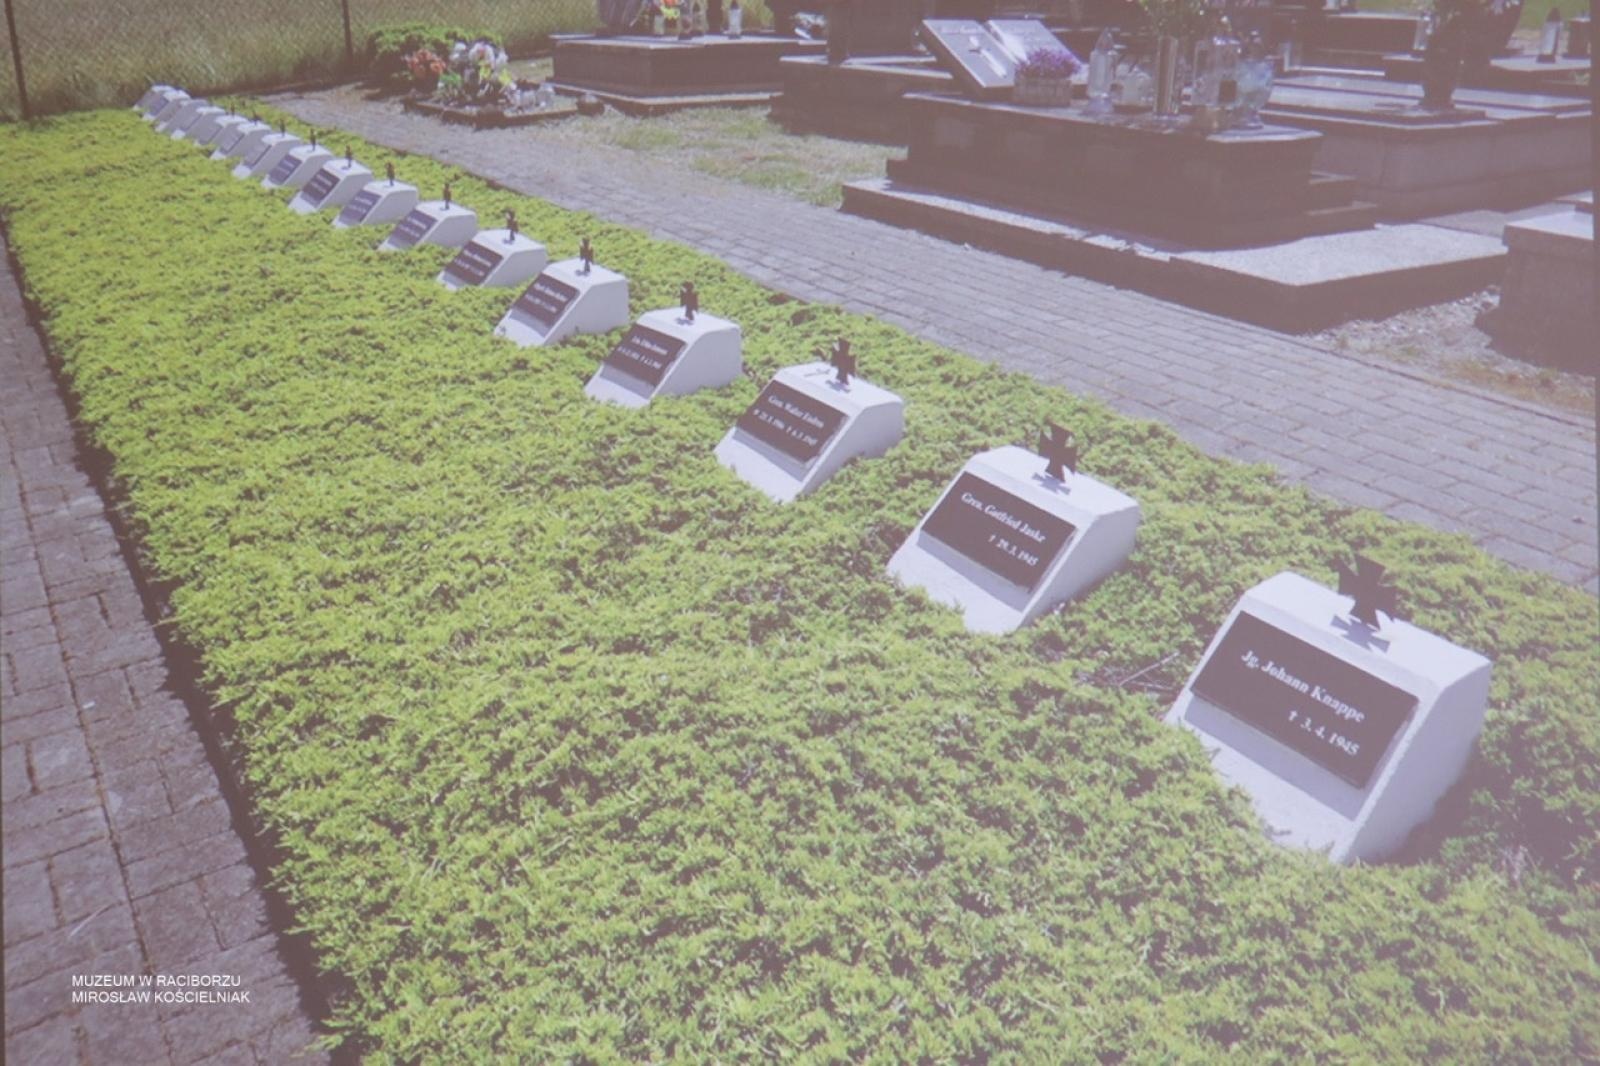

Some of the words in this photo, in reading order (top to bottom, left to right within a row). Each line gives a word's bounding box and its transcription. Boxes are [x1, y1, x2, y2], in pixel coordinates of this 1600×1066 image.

[1241, 650, 1260, 669] Jg.
[1260, 661, 1310, 695] Johann
[1310, 685, 1366, 724] Knappe
[1328, 732, 1361, 757] 1945
